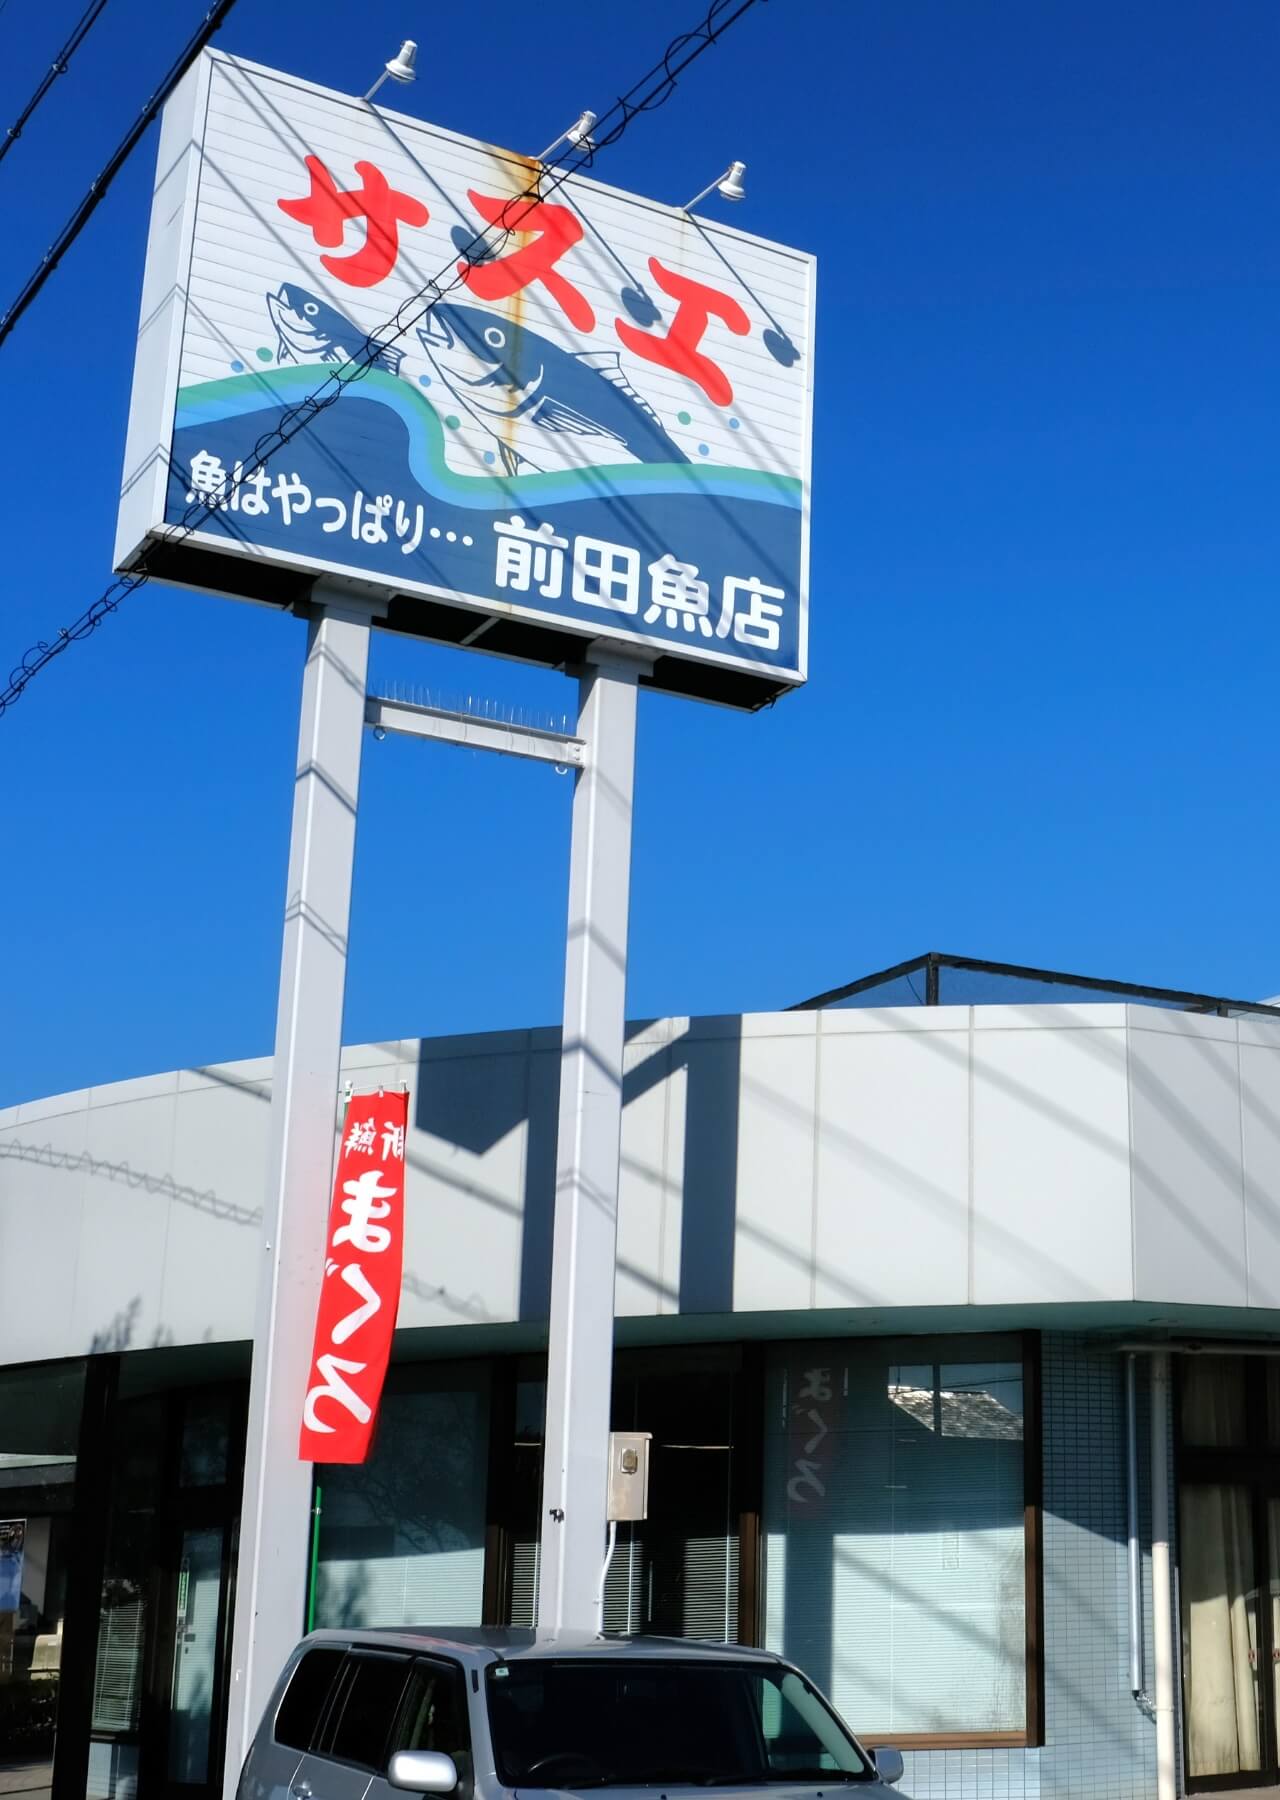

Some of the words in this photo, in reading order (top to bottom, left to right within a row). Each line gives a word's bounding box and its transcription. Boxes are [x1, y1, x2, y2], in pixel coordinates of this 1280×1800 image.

[278, 155, 751, 407] サスエ
[493, 515, 785, 651] 前田魚店
